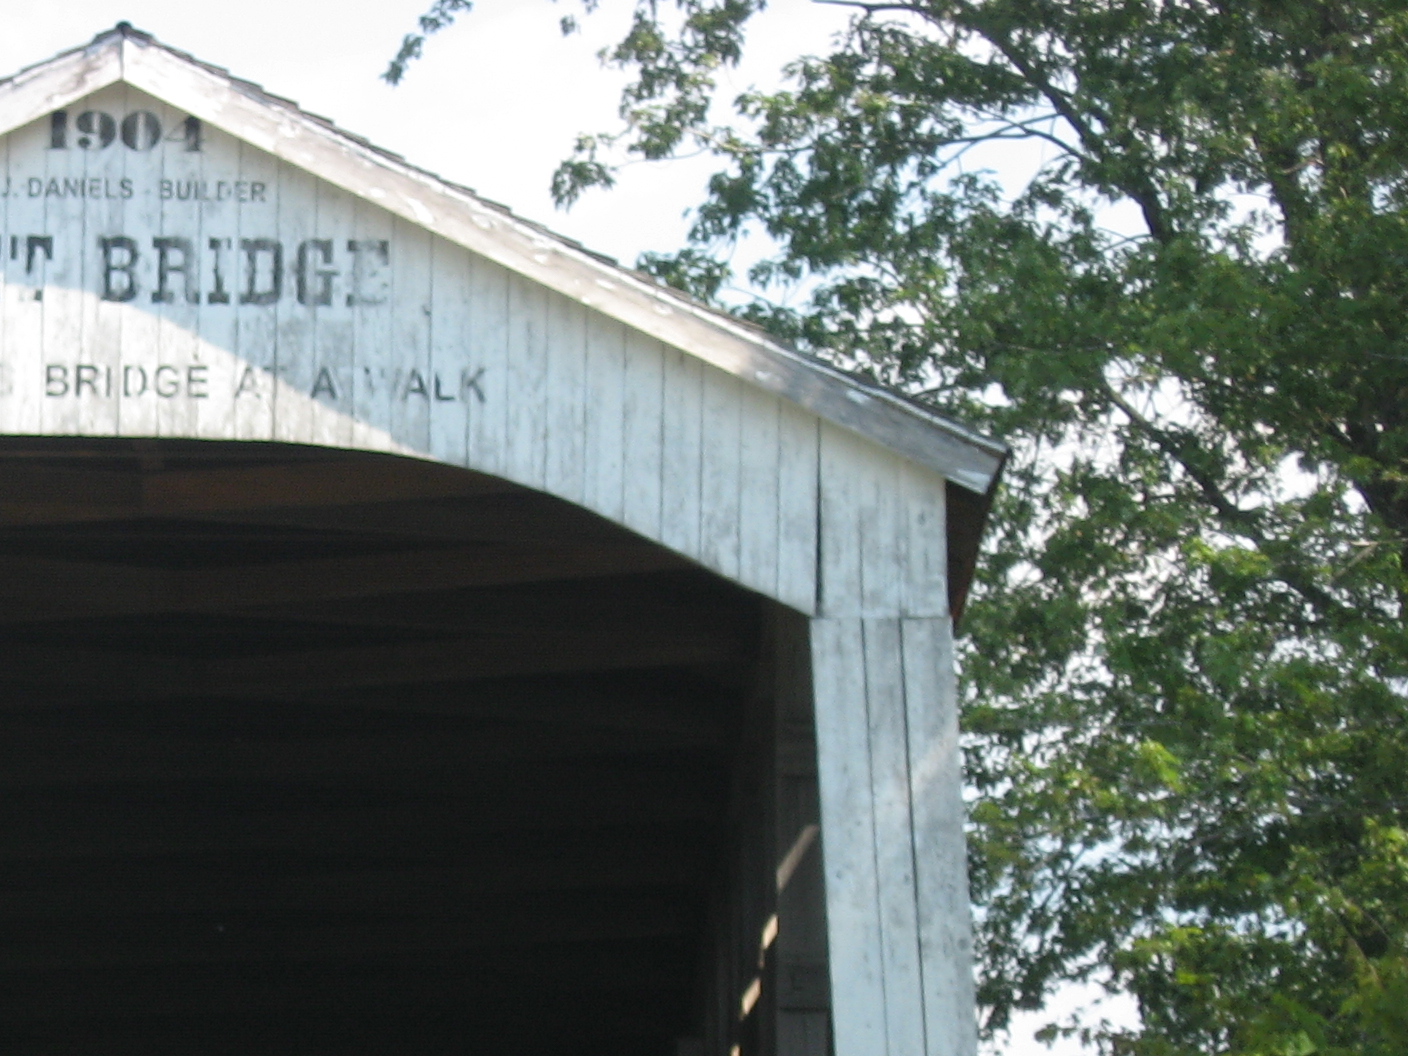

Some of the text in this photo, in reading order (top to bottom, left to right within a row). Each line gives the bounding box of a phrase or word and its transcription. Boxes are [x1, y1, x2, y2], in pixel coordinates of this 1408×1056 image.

[44, 109, 205, 152] 1904
[28, 177, 133, 198] DANIELS
[159, 179, 266, 202] BUILDER
[98, 235, 389, 307] BRIDGE
[45, 363, 209, 399] BRIDGE
[310, 366, 337, 400] A
